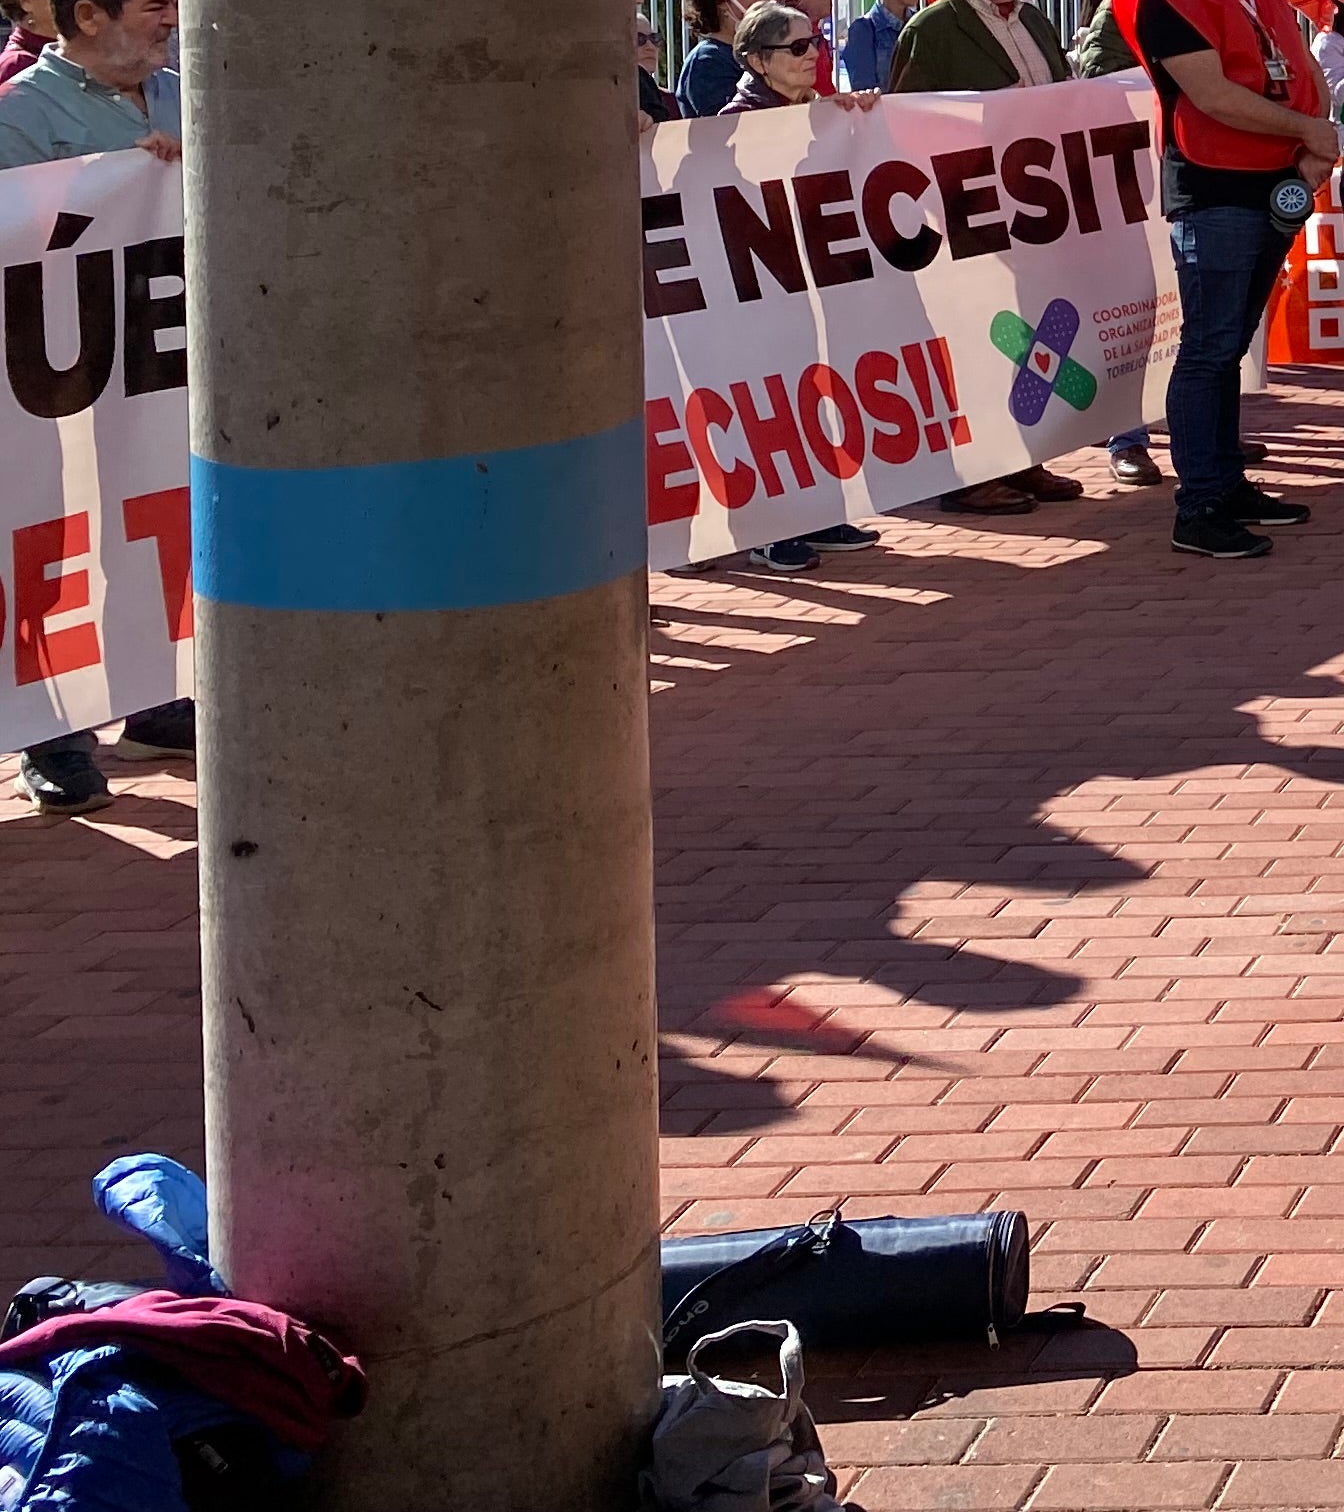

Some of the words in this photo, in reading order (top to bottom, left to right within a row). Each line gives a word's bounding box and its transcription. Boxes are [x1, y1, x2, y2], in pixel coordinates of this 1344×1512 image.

[713, 120, 1164, 304] NECESIT
[1092, 291, 1178, 324] COORDINADORA
[1098, 307, 1181, 343] ORGANIZACIONES
[1103, 348, 1119, 362] DE
